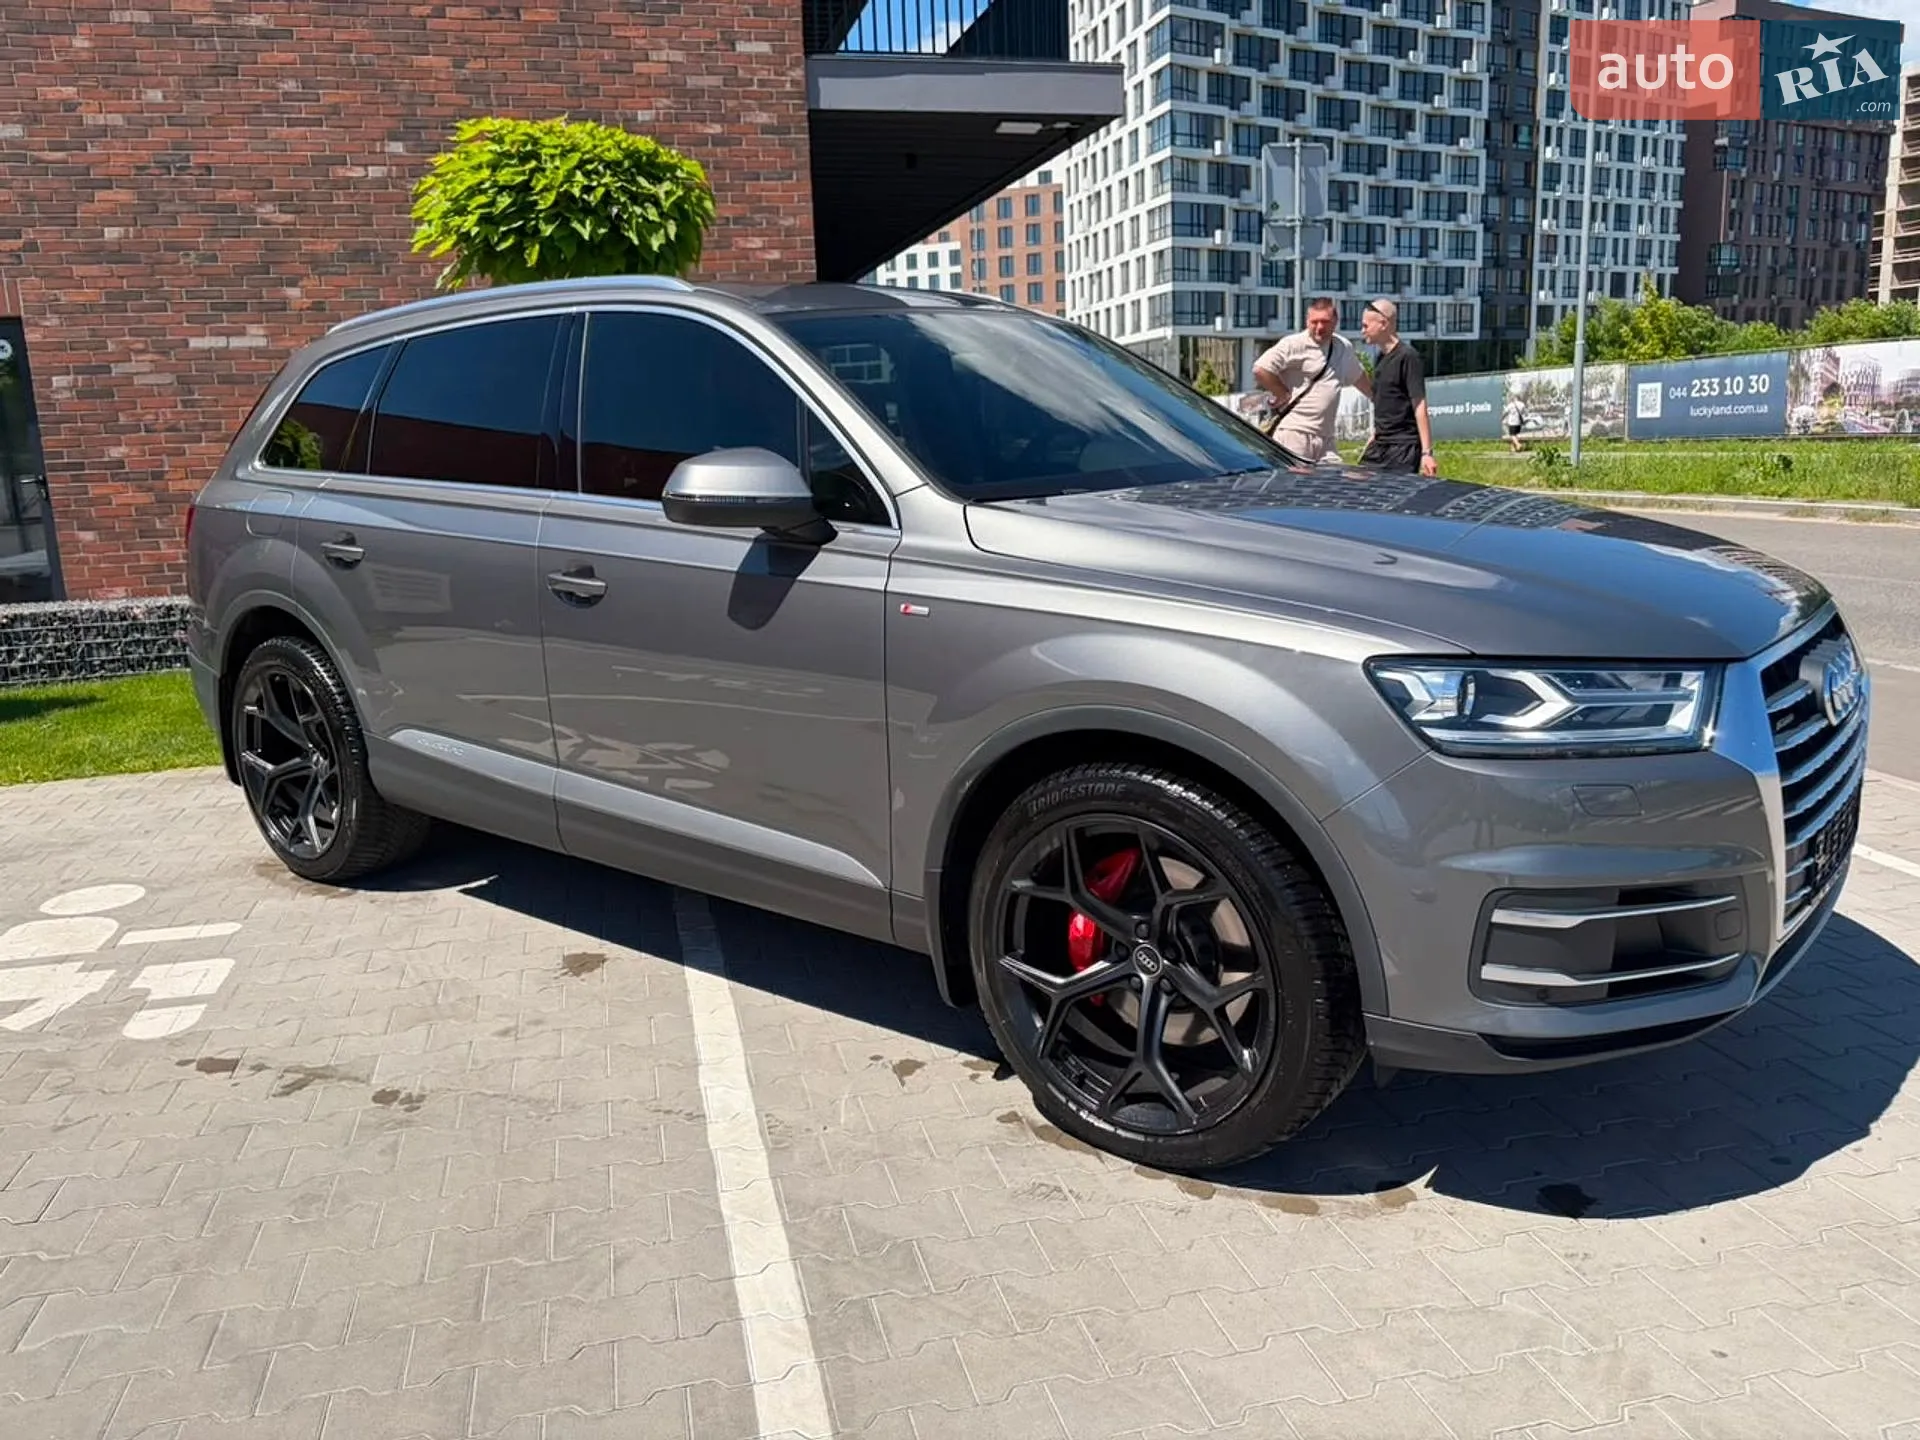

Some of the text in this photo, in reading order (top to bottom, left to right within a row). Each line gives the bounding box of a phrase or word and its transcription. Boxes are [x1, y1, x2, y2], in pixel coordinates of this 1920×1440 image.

[1669, 373, 1770, 399] 044 233 10 30
[1690, 404, 1769, 419] luckyland.com.ua
